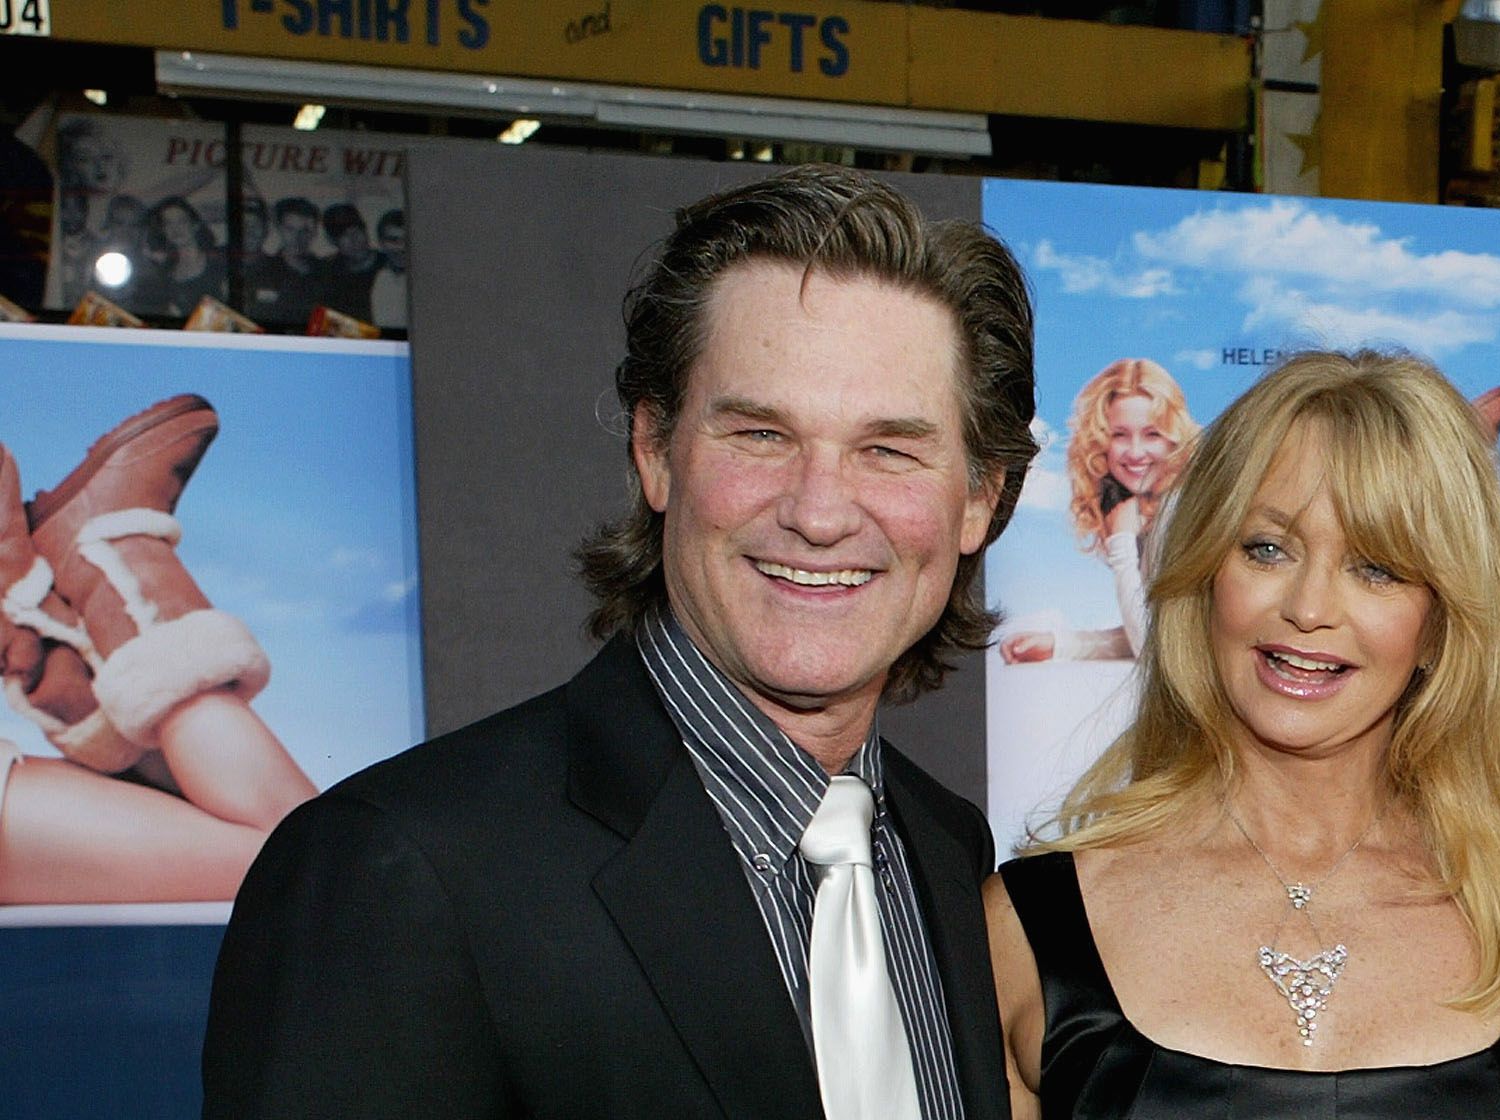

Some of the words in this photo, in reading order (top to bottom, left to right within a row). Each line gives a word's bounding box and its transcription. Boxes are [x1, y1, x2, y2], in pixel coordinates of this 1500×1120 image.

[698, 4, 850, 77] GIFTS
[165, 136, 330, 174] PICURE
[1222, 347, 1283, 366] HELE
